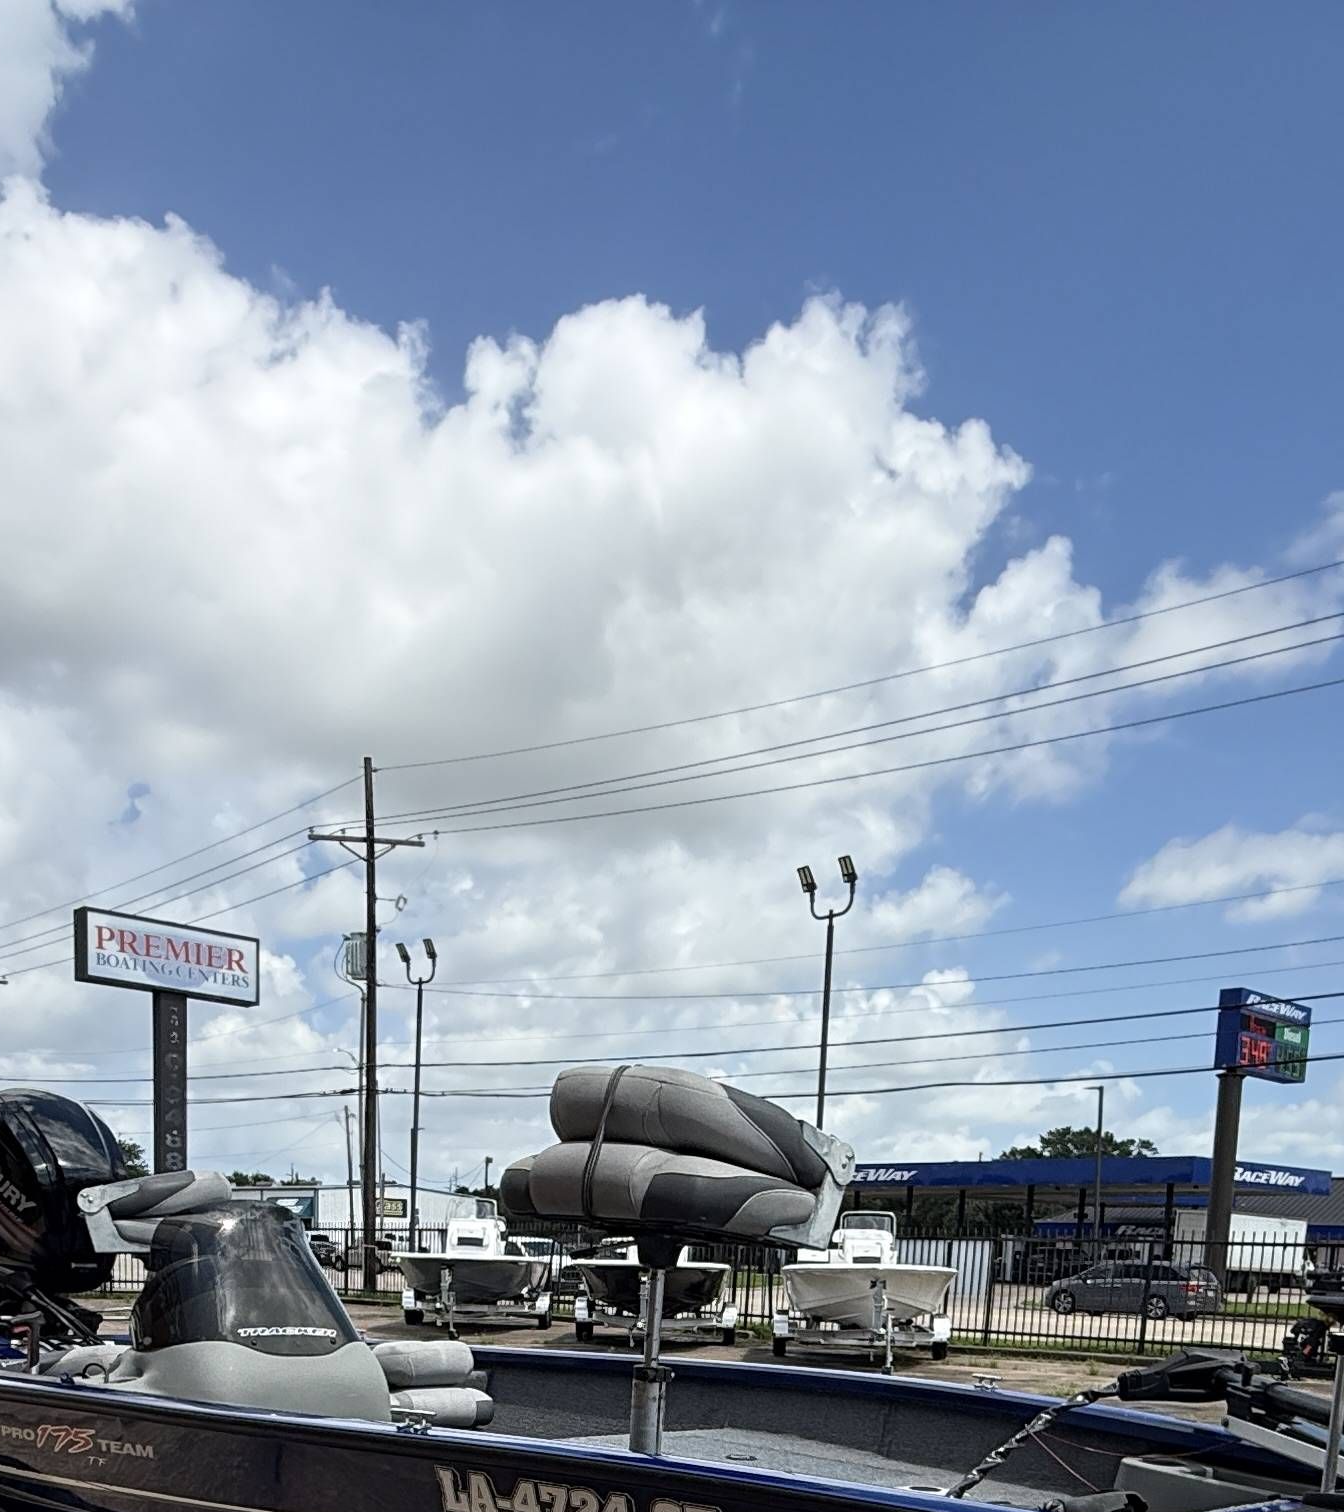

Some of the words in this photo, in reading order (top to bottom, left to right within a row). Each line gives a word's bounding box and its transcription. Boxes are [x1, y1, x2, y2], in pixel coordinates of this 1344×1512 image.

[95, 925, 249, 974] PREMIER
[96, 952, 174, 976] BOATING
[176, 965, 249, 988] CENTERS
[0, 1425, 35, 1441] PRO
[36, 1424, 96, 1453] 175
[97, 1439, 156, 1459] TEAM
